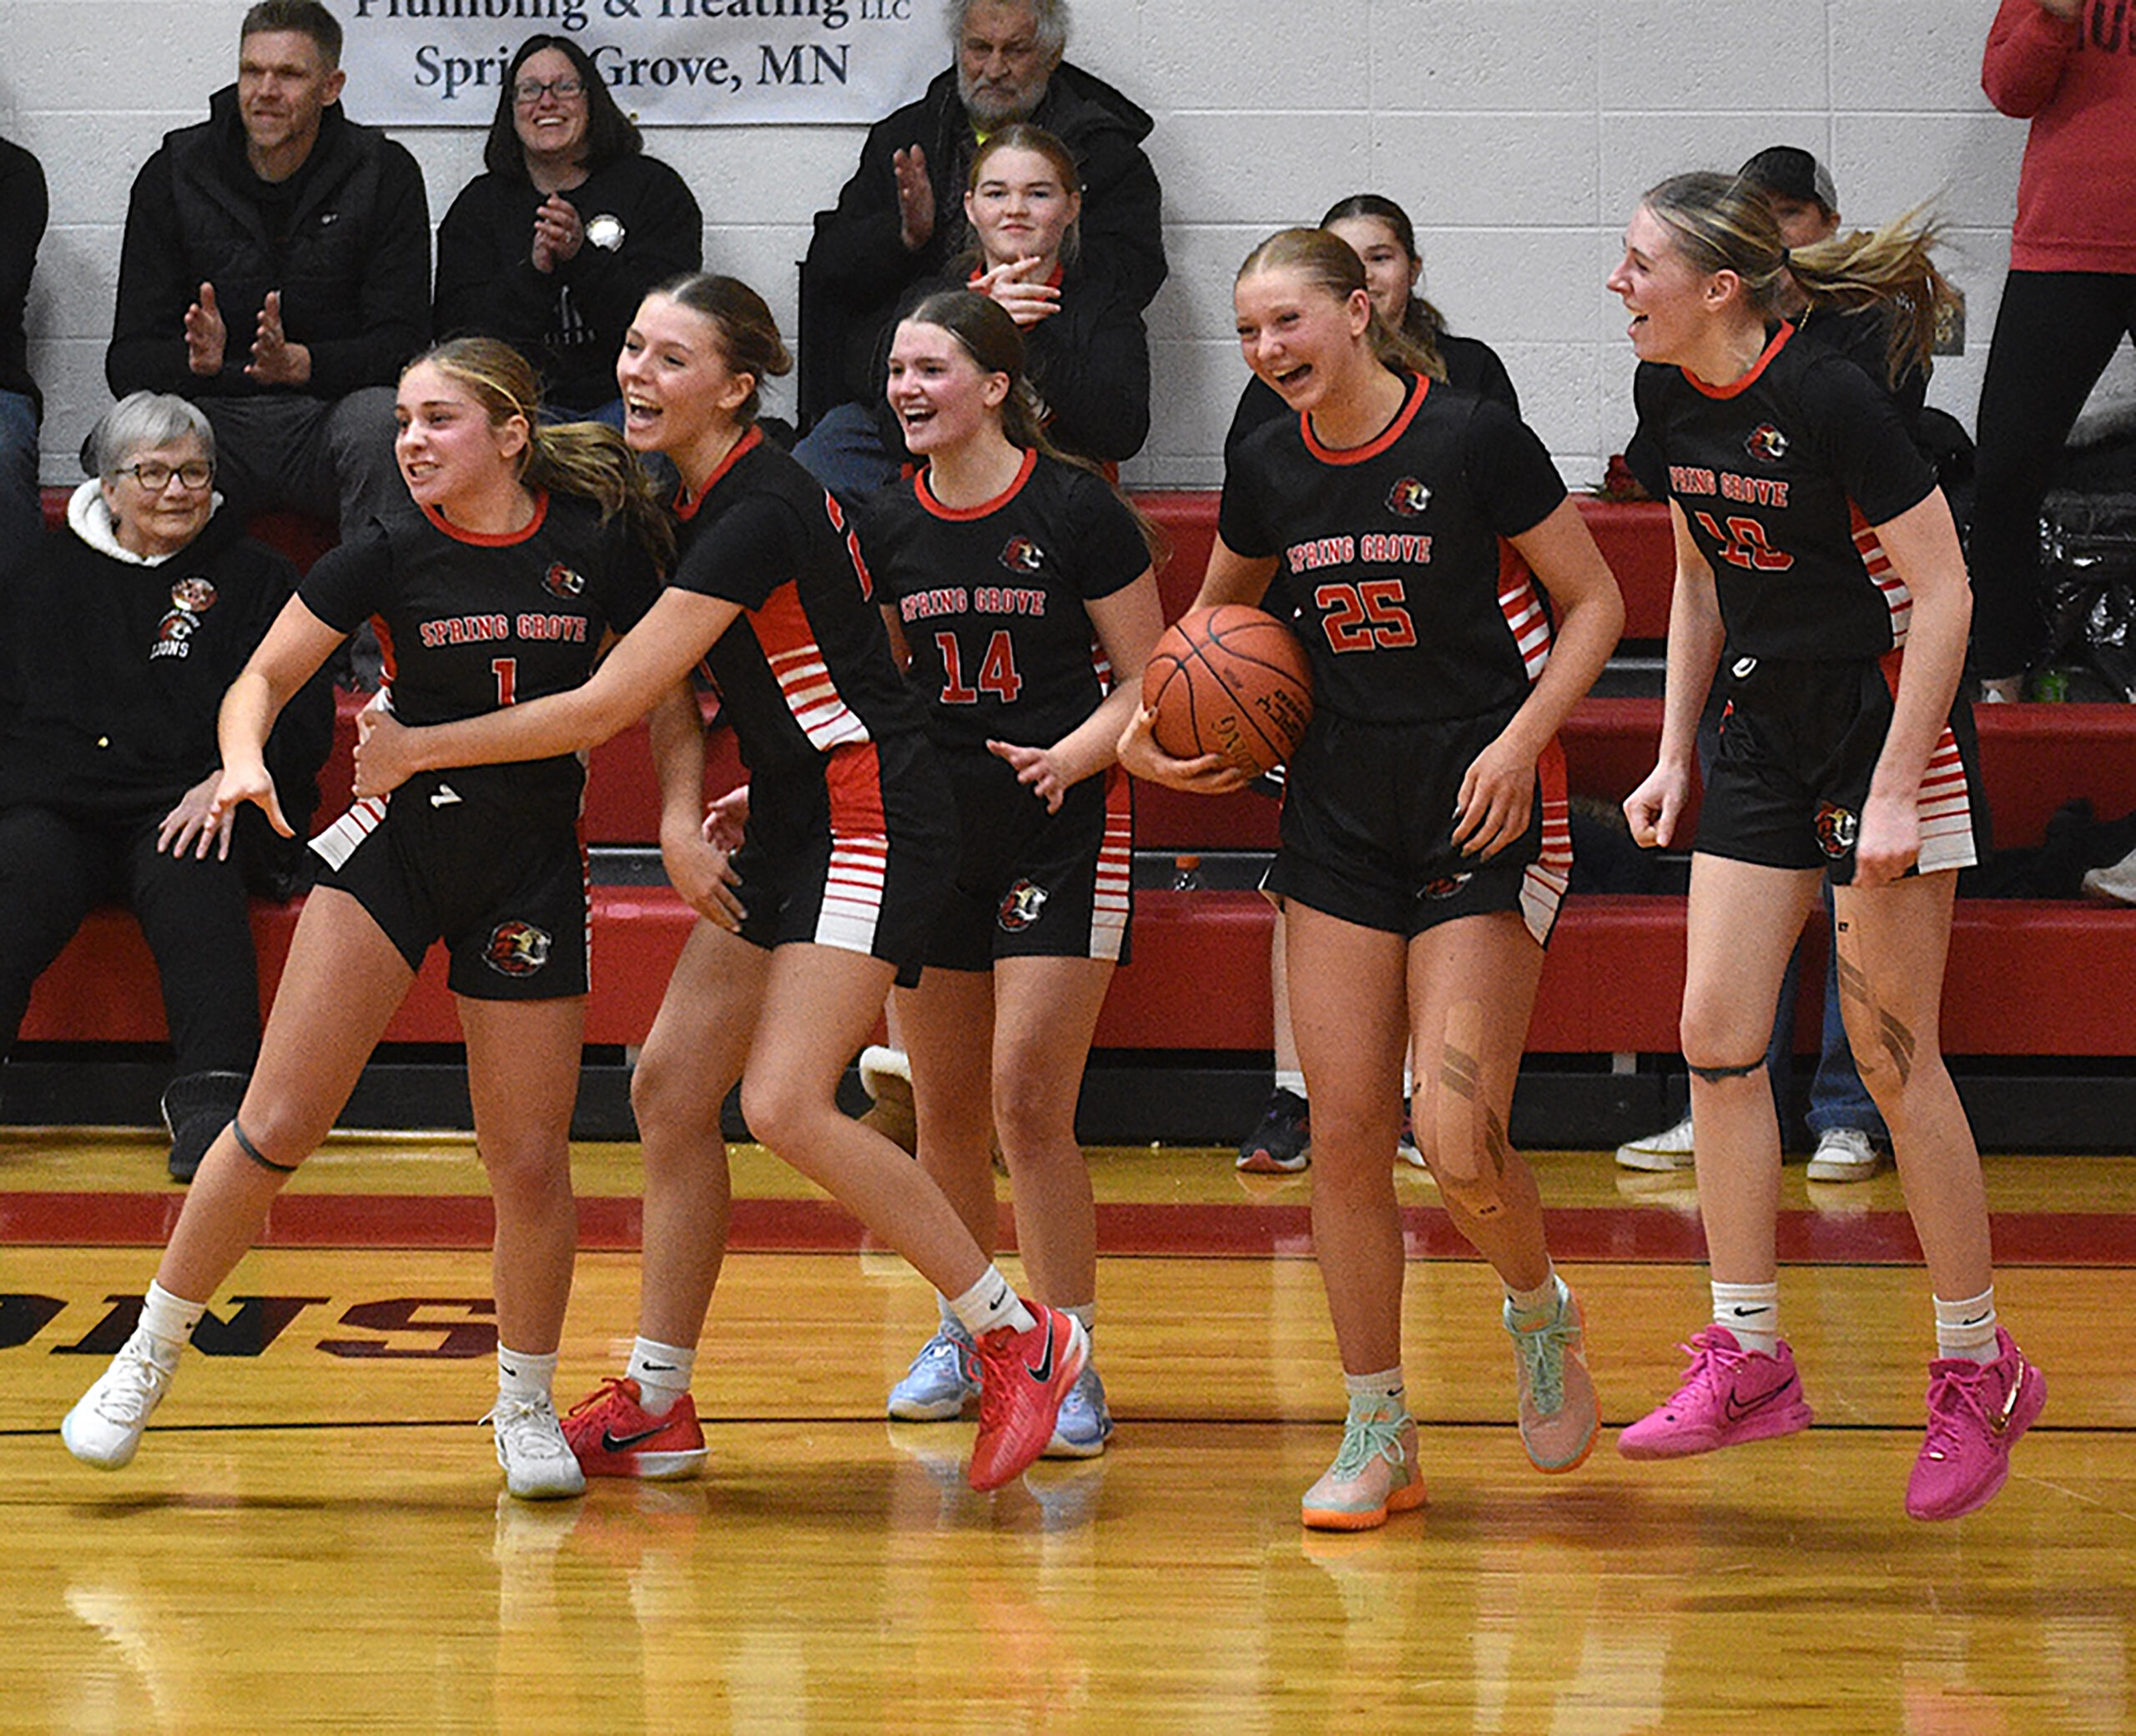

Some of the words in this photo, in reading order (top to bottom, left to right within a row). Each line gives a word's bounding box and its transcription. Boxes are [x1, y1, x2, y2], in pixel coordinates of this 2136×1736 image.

[860, 0, 911, 20] LLC
[414, 45, 509, 99] Spri
[591, 45, 743, 93] Grove,
[757, 44, 851, 85] MN
[1669, 465, 1717, 496] PRING
[1720, 472, 1789, 507] GROVE
[1361, 534, 1432, 564] GROVE
[975, 587, 1046, 616] GROVE
[1314, 579, 1418, 653] 25
[420, 614, 509, 647] SPRING
[516, 613, 587, 642] GROVE
[491, 657, 516, 707] 1
[934, 630, 1022, 703] 14
